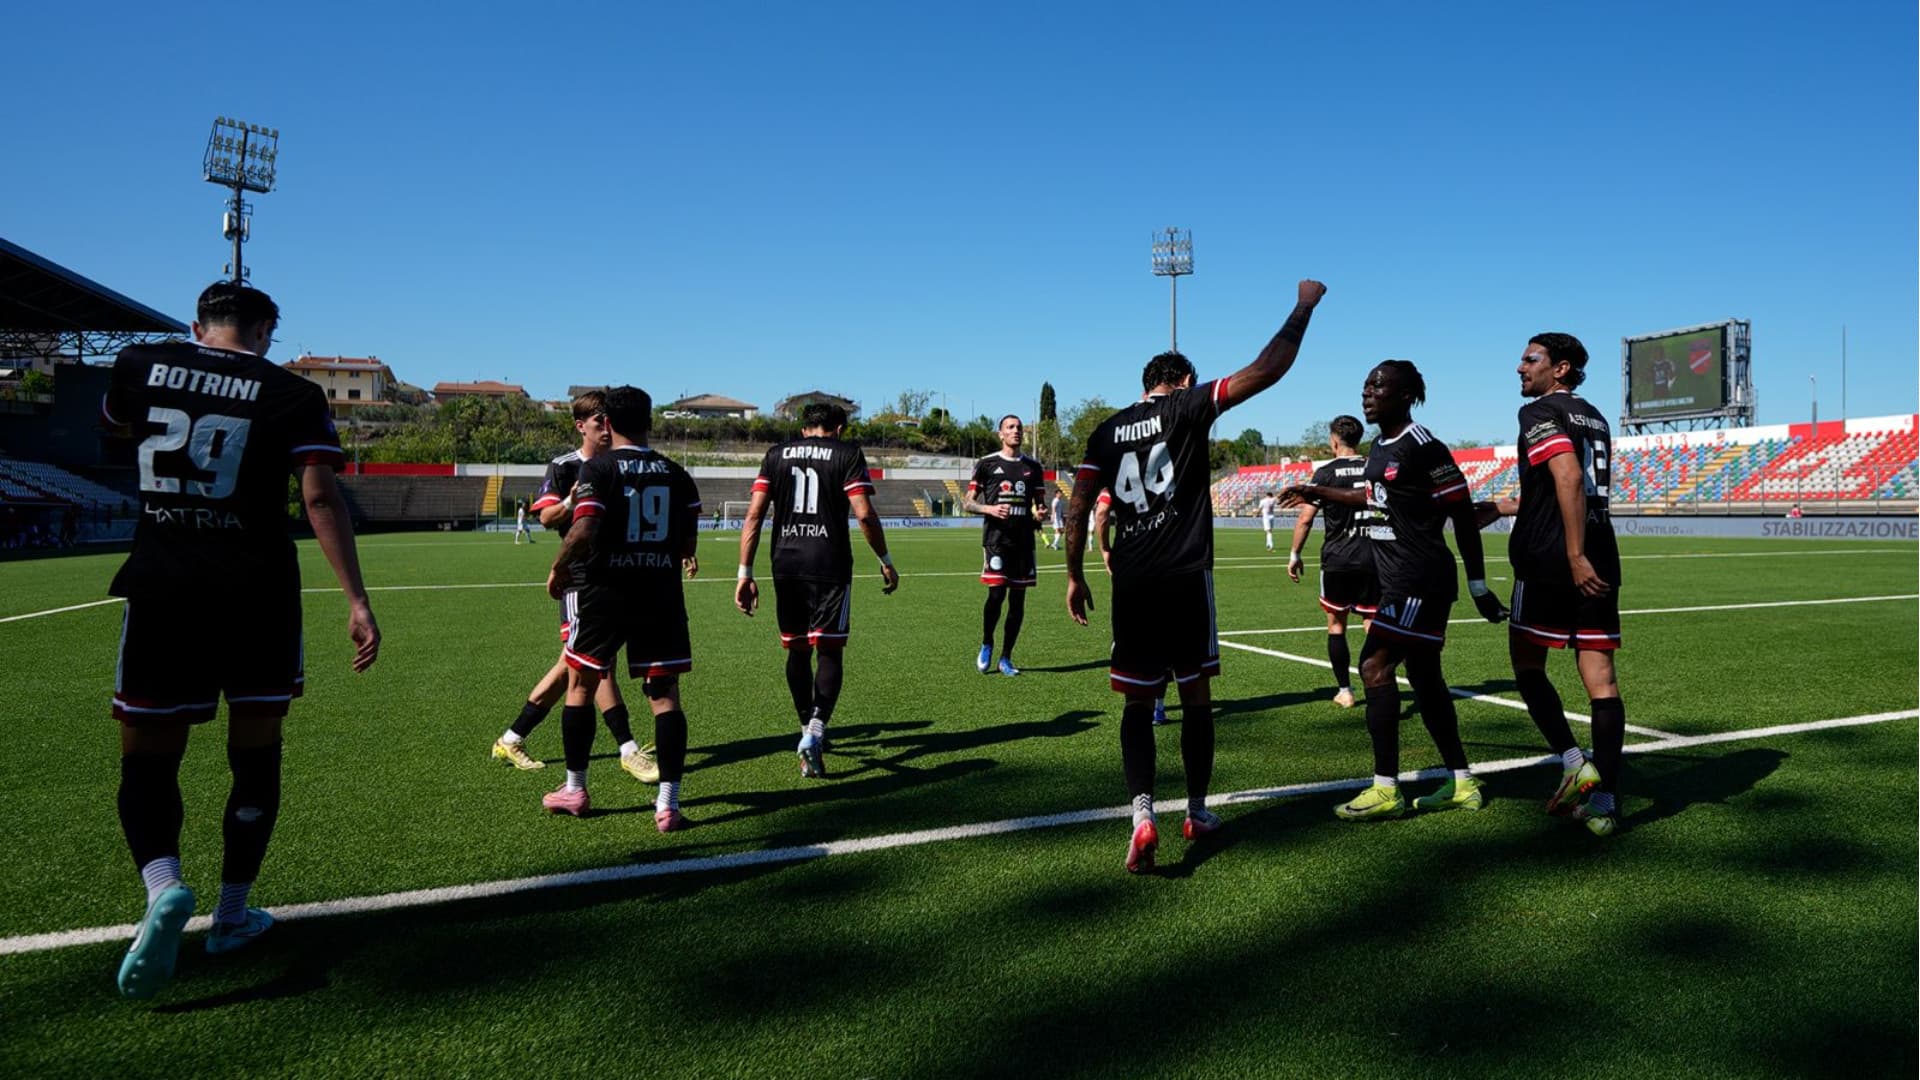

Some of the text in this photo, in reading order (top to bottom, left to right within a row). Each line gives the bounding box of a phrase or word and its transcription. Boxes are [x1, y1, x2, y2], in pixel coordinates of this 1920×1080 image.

[147, 363, 263, 401] BOTRINI
[1114, 415, 1162, 443] MILTON
[137, 406, 252, 499] 29
[782, 446, 833, 460] CARPANI
[791, 466, 819, 514] 11
[1114, 441, 1176, 514] 44
[623, 485, 671, 542] 19
[780, 523, 829, 537] HATRIA
[1761, 521, 1919, 538] STABILIZZAZIONE
[609, 552, 673, 568] HATRIA
